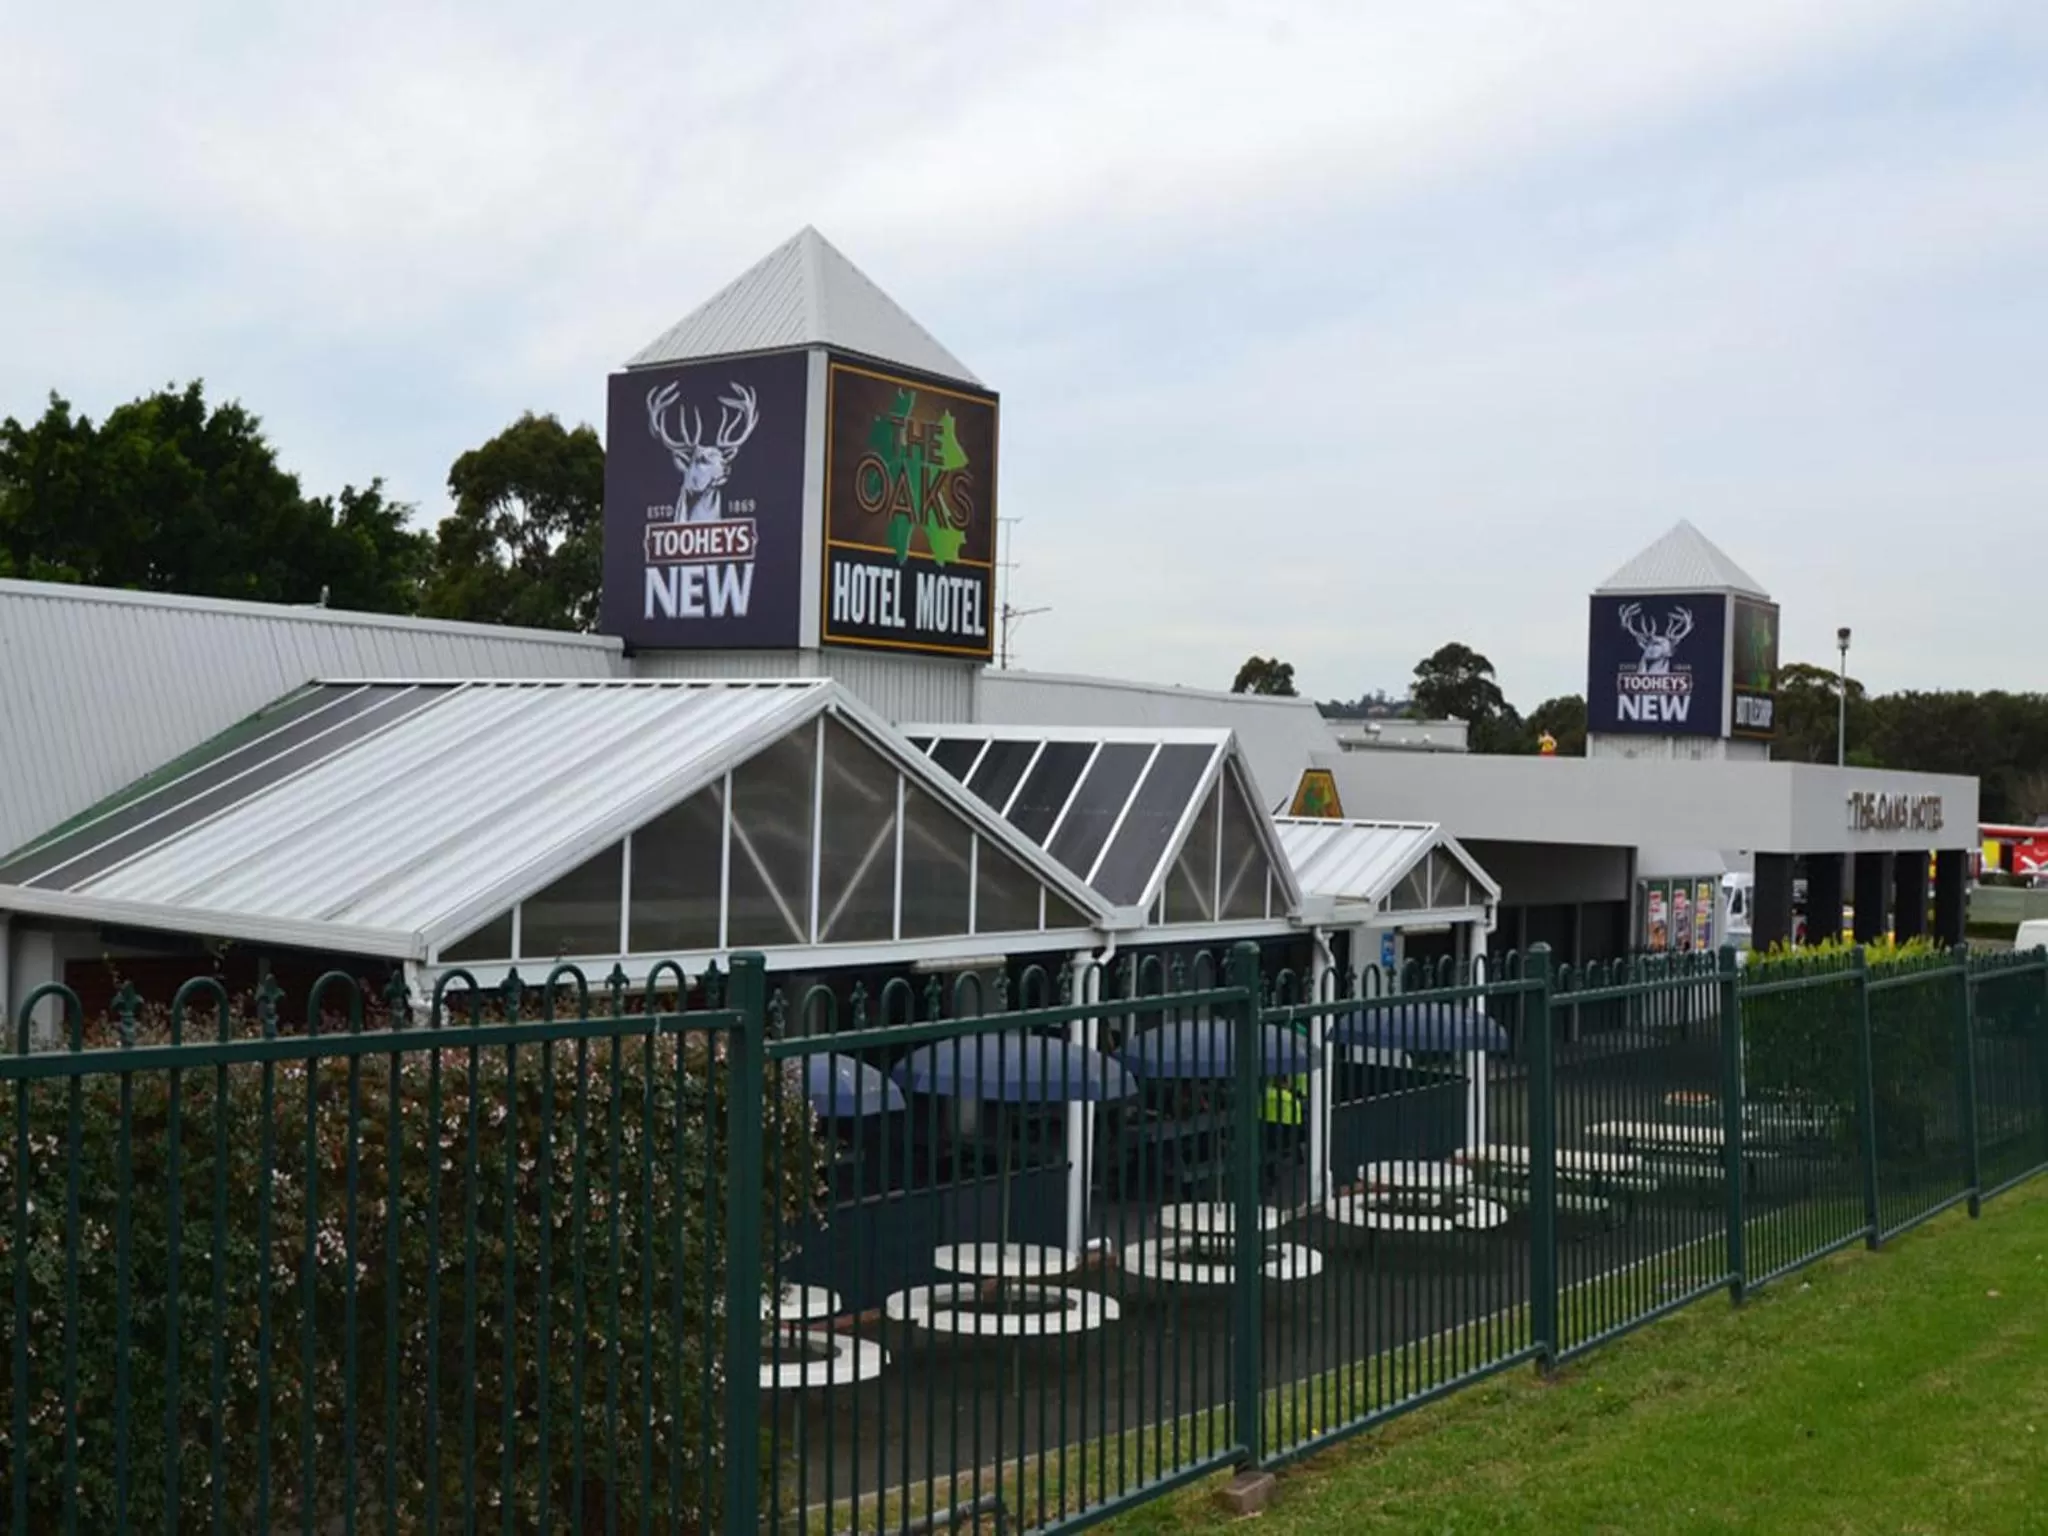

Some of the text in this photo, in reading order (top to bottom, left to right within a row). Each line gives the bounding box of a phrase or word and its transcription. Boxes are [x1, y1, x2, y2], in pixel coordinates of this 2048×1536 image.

[889, 416, 944, 465] THE
[856, 451, 974, 529] OAKS
[647, 499, 755, 519] ESTD 1869
[651, 527, 750, 556] TOOHEYS
[645, 563, 753, 619] NEW
[834, 562, 985, 636] HOTEL MOTEL
[1624, 676, 1688, 691] TOOHEYS
[1617, 695, 1690, 721] NEW
[1910, 795, 1944, 831] HOTEL
